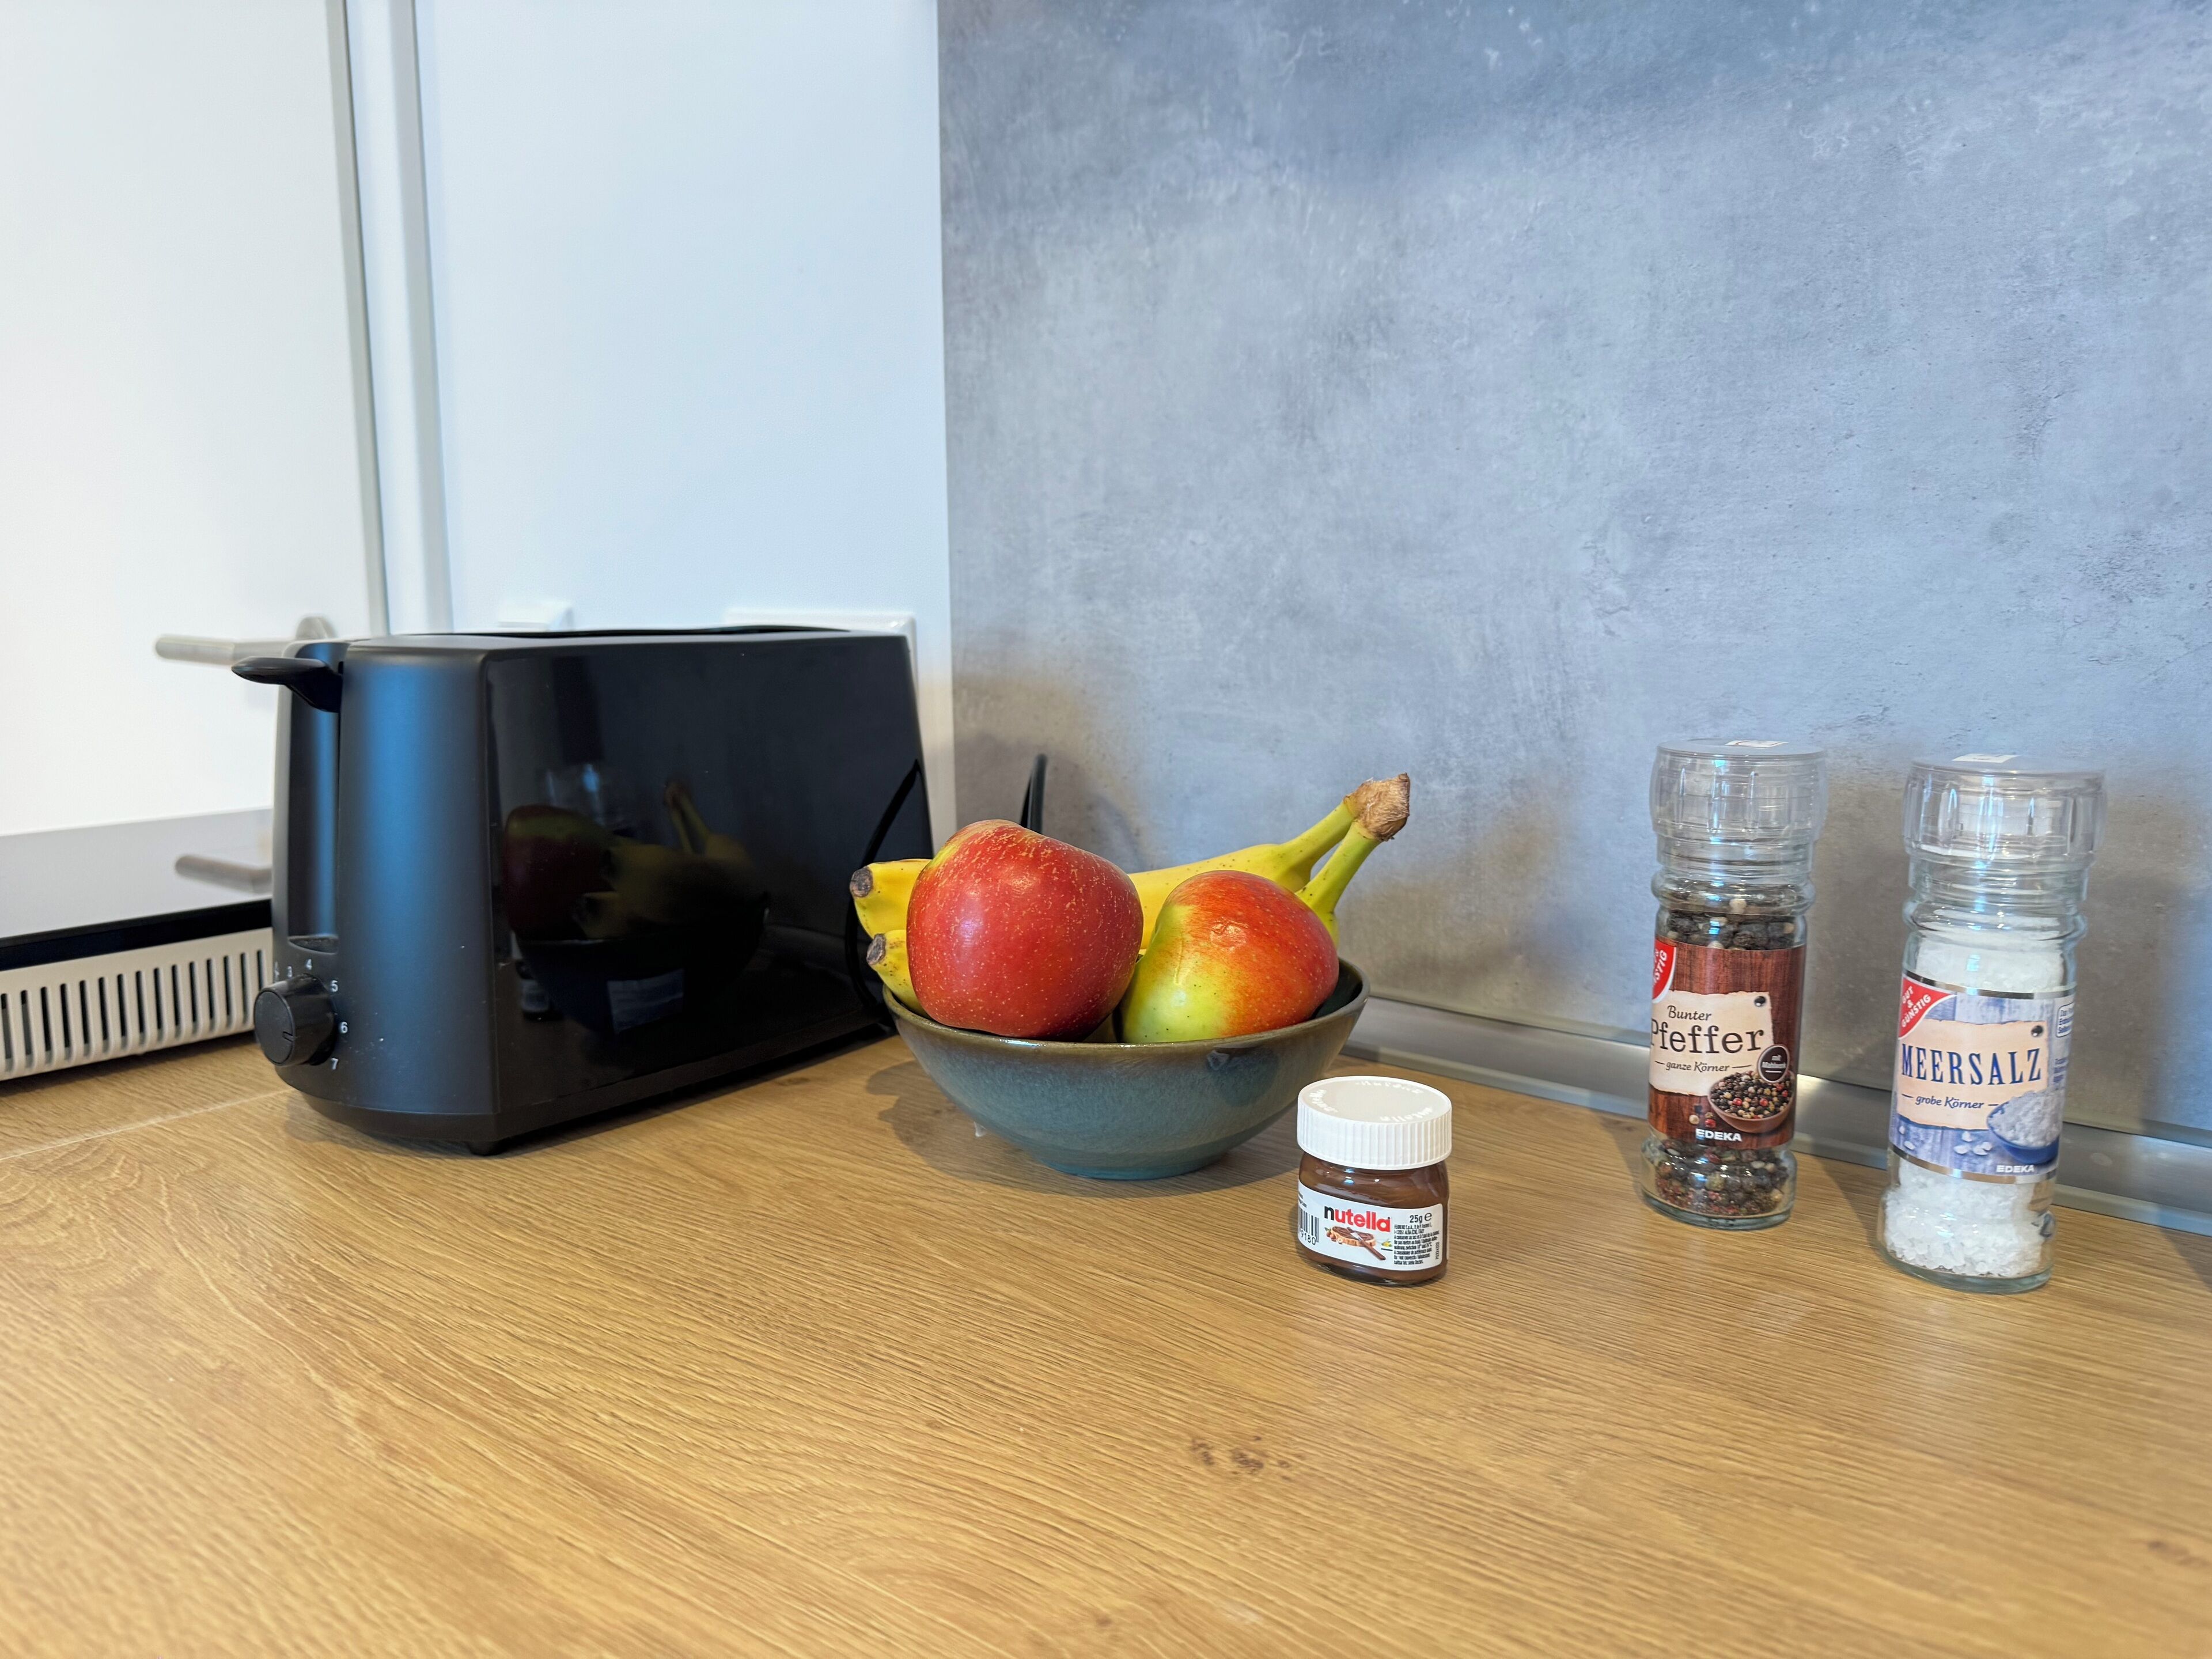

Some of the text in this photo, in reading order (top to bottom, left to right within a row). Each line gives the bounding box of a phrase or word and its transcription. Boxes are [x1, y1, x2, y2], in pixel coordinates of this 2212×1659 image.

[305, 959, 312, 970] 4
[331, 980, 339, 992] 5
[1902, 986, 1914, 1004] GUT
[1667, 1005, 1712, 1021] Bunter
[1902, 994, 1931, 1028] GÜNSTIG
[341, 1021, 348, 1033] 6
[1650, 1018, 1764, 1054] Pfeffer
[332, 1058, 339, 1070] 7
[1665, 1061, 1730, 1073] ganze Körner
[1902, 1043, 2041, 1086] MEERSALZ
[1915, 1096, 1984, 1109] grobe Körner
[1695, 1128, 1743, 1142] EDEKA
[1995, 1164, 2035, 1173] EDEKA
[1324, 1206, 1391, 1232] nutella
[1409, 1214, 1423, 1224] 25g
